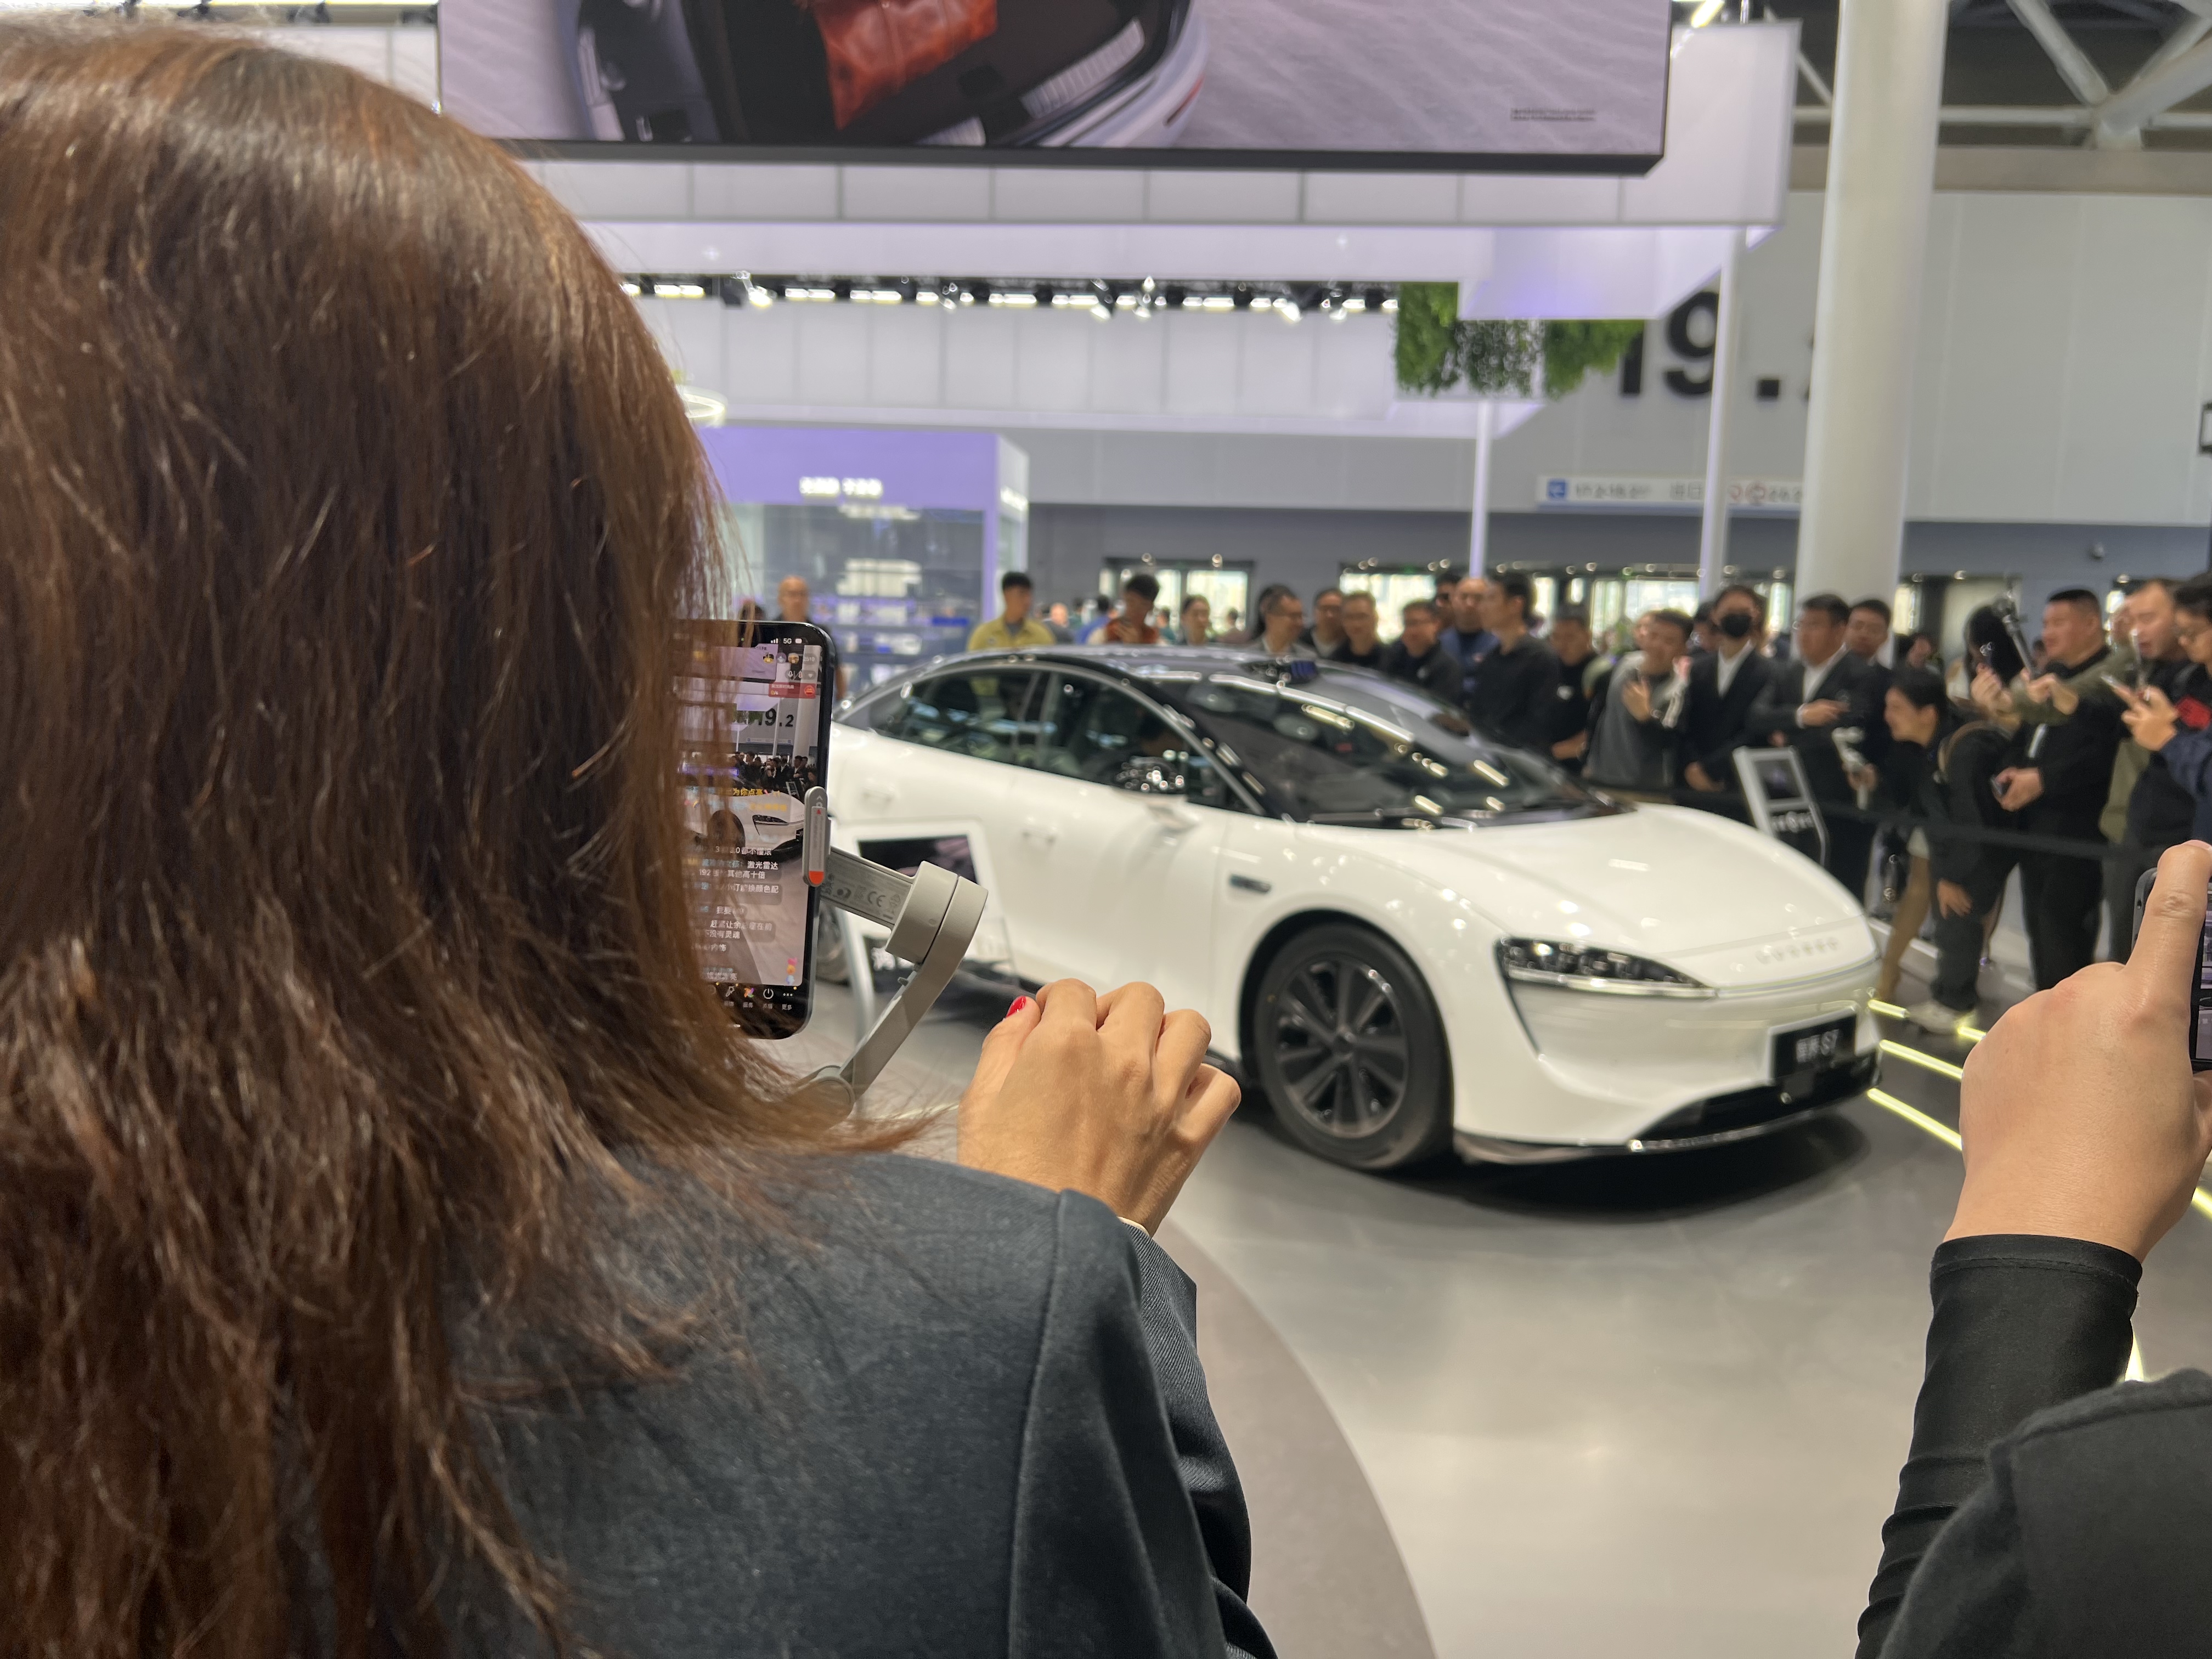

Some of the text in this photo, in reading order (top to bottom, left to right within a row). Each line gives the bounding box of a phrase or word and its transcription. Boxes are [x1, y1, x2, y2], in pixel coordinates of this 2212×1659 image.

[1620, 290, 1814, 400] 19.
[747, 860, 778, 870] 激光雷达
